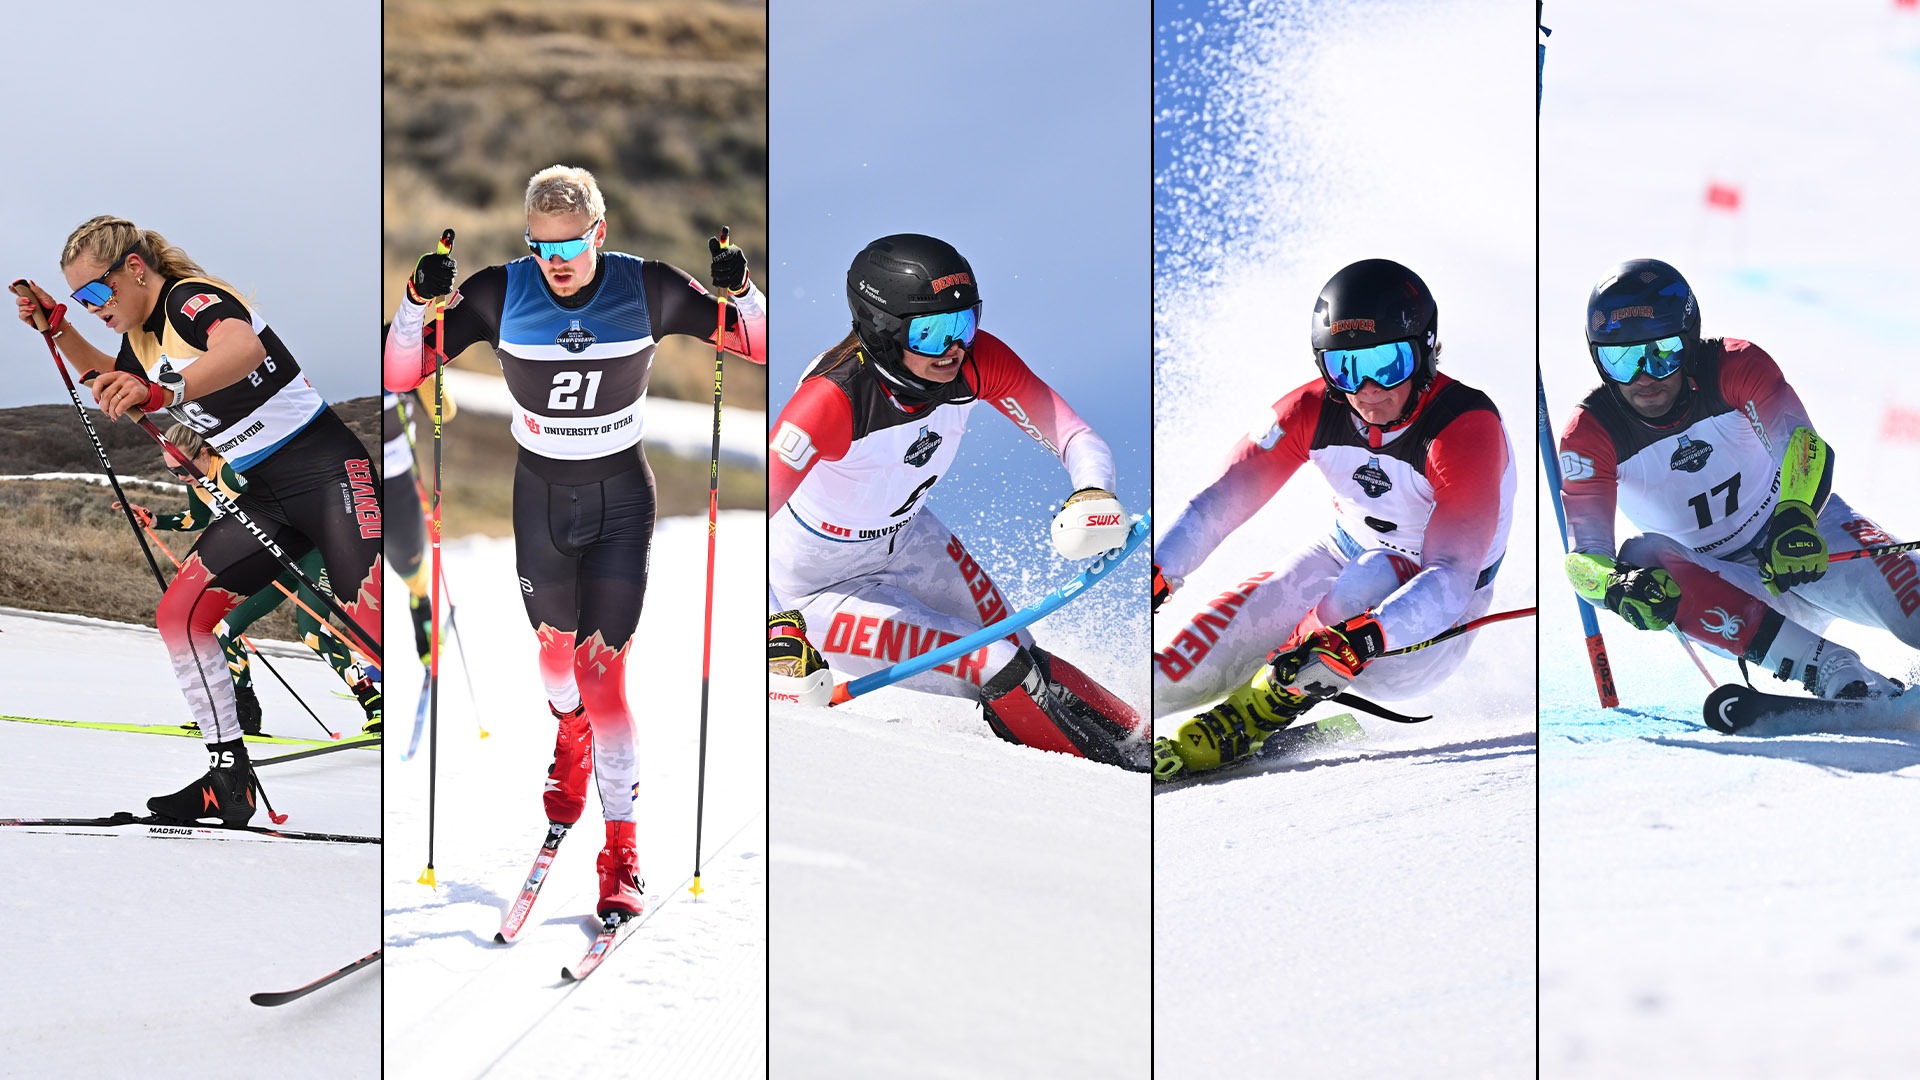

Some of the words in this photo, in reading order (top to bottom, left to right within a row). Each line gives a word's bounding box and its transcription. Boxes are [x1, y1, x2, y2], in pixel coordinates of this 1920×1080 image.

[931, 272, 971, 294] DENVER
[1611, 306, 1655, 324] DENVER
[1331, 318, 1376, 336] DENVER
[715, 360, 723, 395] LEKI
[547, 370, 603, 410] 21
[243, 420, 265, 438] UTAH
[544, 426, 599, 436] UNIVERSITY
[601, 425, 612, 434] OF
[614, 414, 633, 430] UTAH
[1809, 433, 1818, 460] LEKI
[1769, 467, 1781, 495] UTA
[345, 459, 381, 539] DENVER
[1688, 472, 1742, 530] 17
[198, 475, 285, 558] MADSHUS
[1086, 514, 1121, 527] SWIX
[1788, 541, 1814, 549] LEKI
[1876, 543, 1918, 556] LEKI
[1154, 571, 1276, 682] DENVER
[1342, 647, 1358, 667] LEK
[1813, 638, 1826, 662] HEA
[148, 827, 193, 836] MADSHUS
